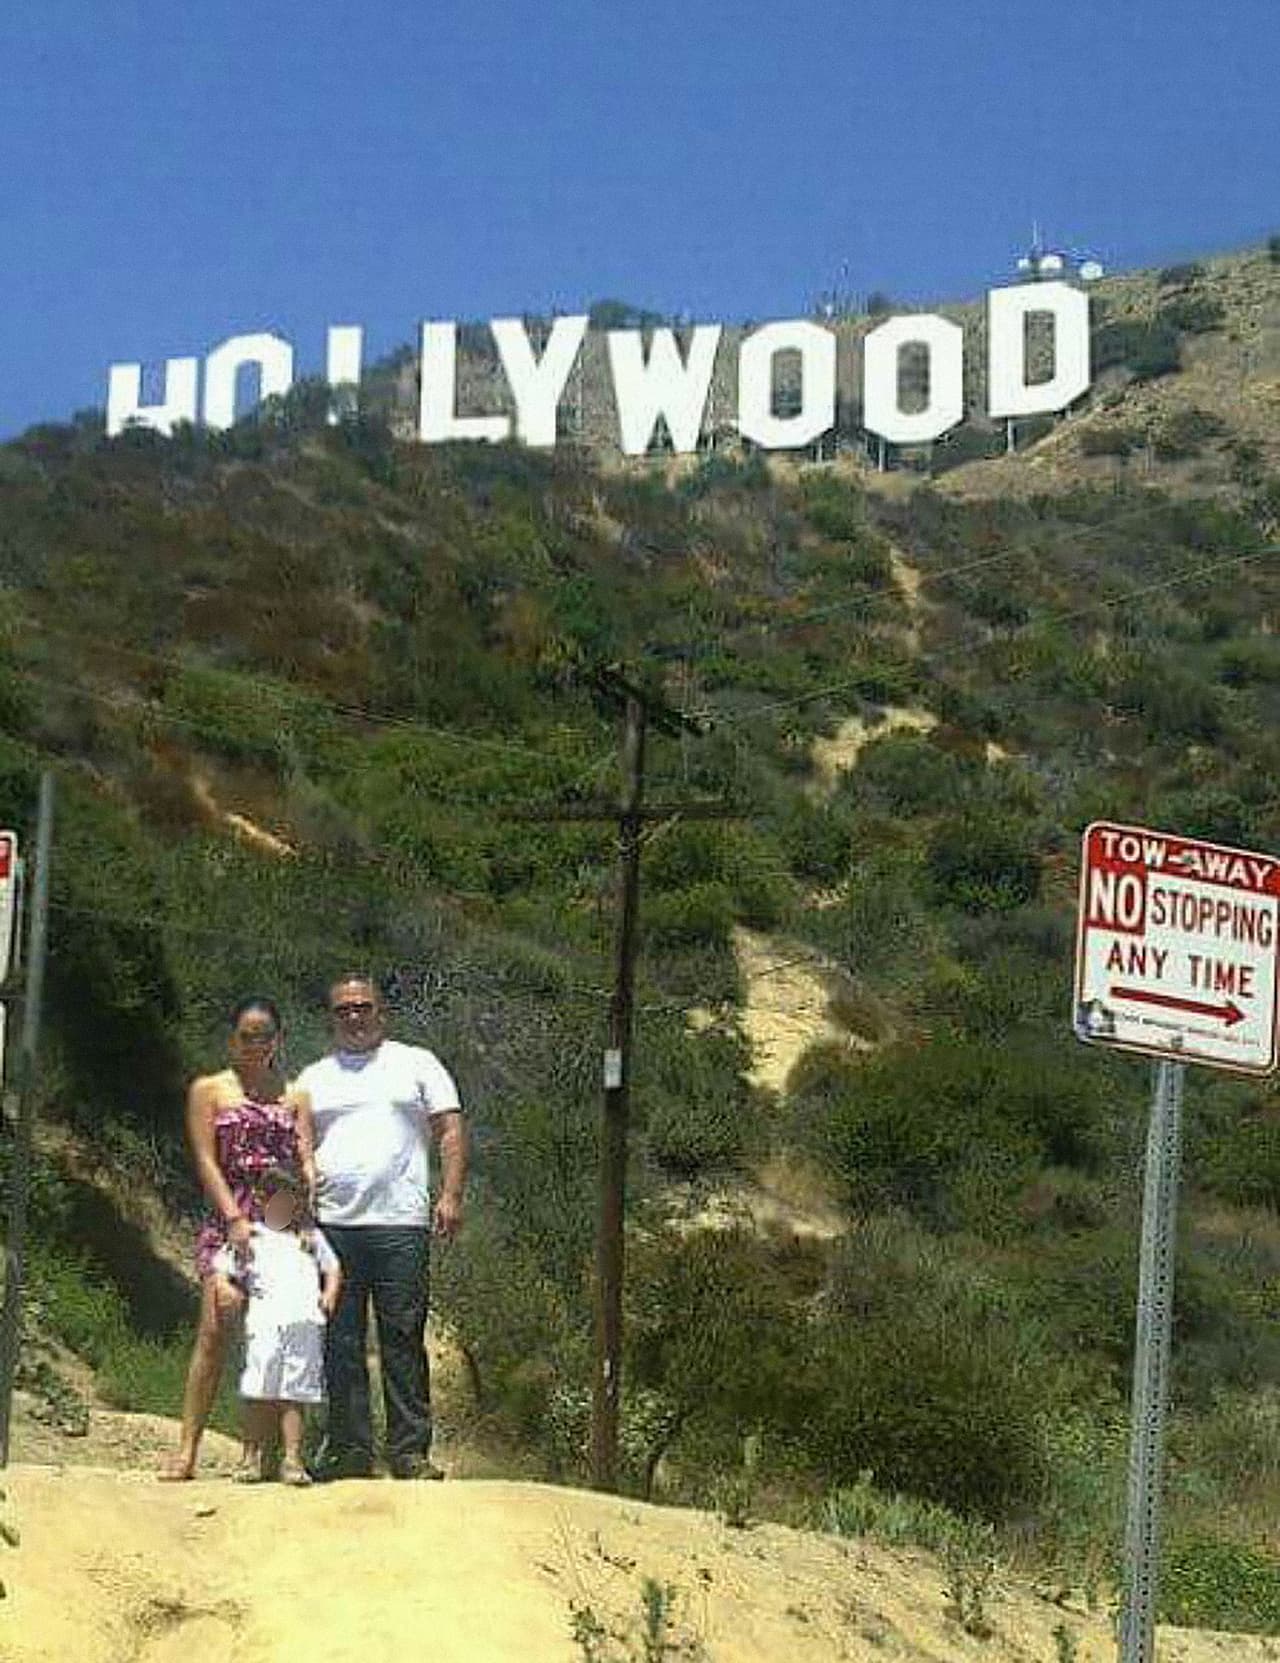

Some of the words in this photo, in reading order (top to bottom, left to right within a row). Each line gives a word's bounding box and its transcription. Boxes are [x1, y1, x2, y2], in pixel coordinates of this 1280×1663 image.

[1089, 868, 1143, 928] NO
[1150, 887, 1273, 949] STOPPING
[1106, 940, 1168, 979] ANY
[1188, 954, 1255, 998] TIME
